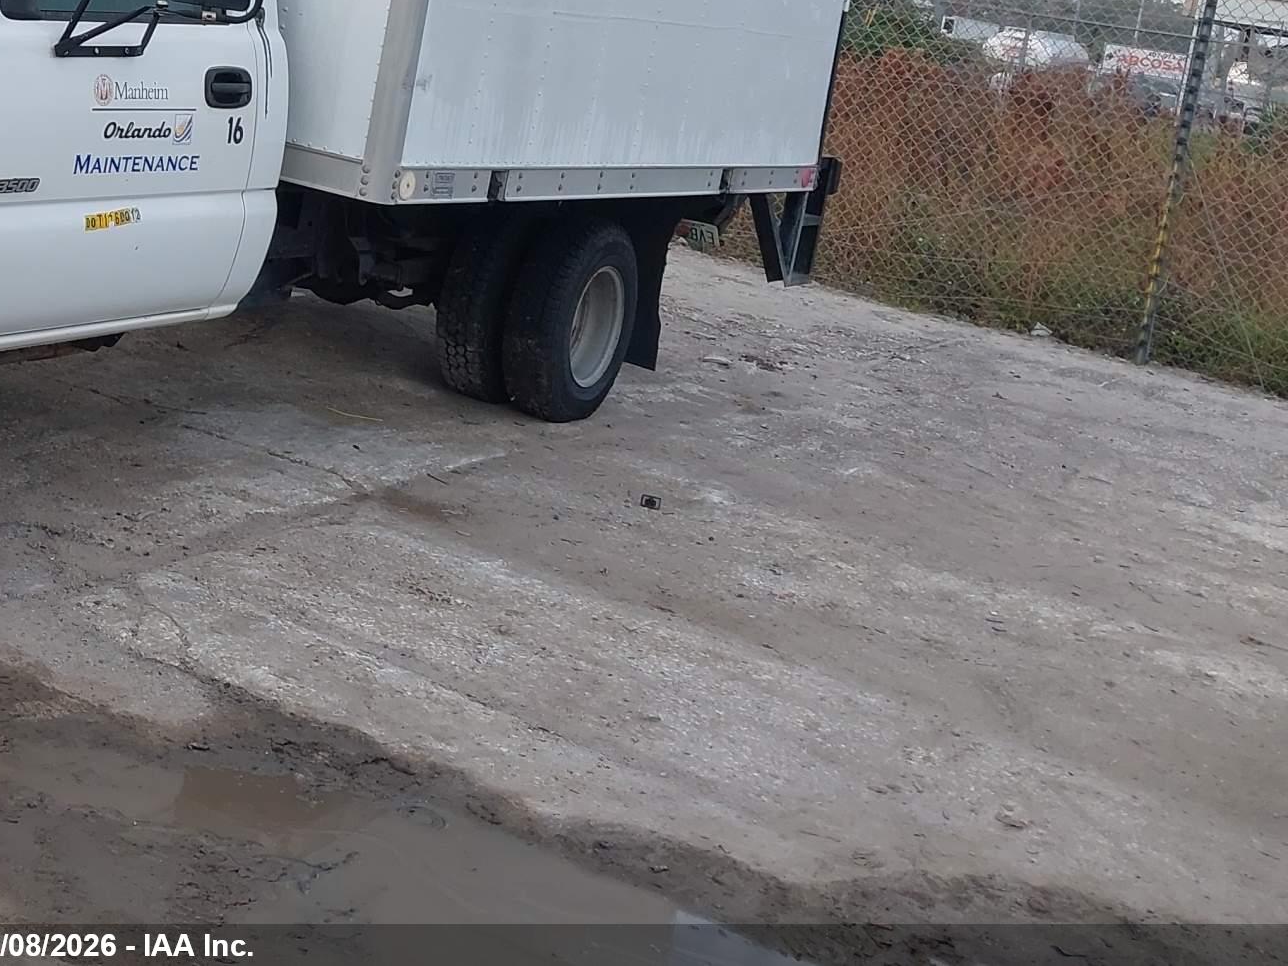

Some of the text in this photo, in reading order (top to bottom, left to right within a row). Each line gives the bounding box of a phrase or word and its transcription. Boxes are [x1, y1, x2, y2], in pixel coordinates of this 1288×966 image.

[114, 81, 169, 100] Manheim
[103, 121, 172, 139] Orlando
[227, 117, 243, 144] 16
[73, 154, 200, 174] MAINTENANCE
